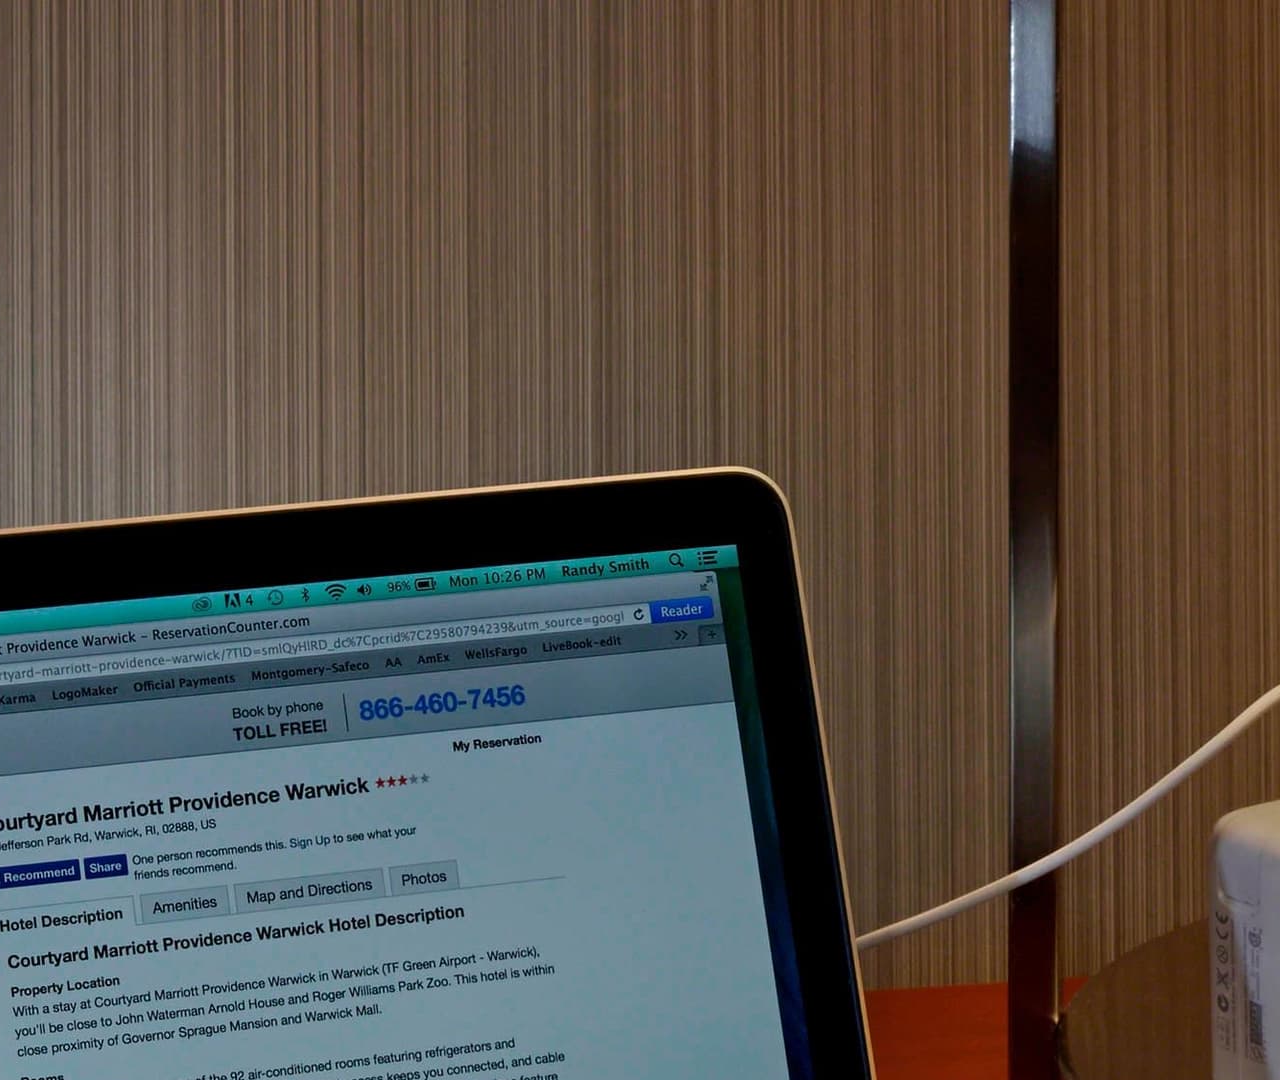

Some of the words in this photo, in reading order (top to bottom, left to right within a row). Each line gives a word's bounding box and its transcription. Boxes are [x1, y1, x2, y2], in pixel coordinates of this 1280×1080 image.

[561, 561, 605, 577] Randy
[608, 556, 650, 573] Smith
[448, 575, 478, 587] Mon
[483, 569, 522, 585] 10:26
[525, 567, 546, 581] PM
[660, 603, 702, 617] Reader
[6, 638, 79, 658] Providence
[81, 630, 138, 649] Warwick
[151, 617, 310, 641] ReservationCounter.com
[541, 634, 622, 653] LiveBook-edit
[416, 650, 450, 666] AmEx
[464, 642, 528, 661] WellsFargo
[251, 660, 370, 684] Montgomery-Safeco
[384, 656, 403, 669] AA
[51, 684, 119, 704] LogoMaker
[132, 677, 176, 696] Official
[178, 673, 236, 690] Payments
[231, 704, 265, 720] Book
[266, 703, 283, 718] by
[284, 700, 324, 717] phone
[358, 683, 526, 721] 866-460-7456
[232, 724, 277, 742] TOLL
[279, 718, 328, 737] FREE!
[452, 740, 471, 753] My
[472, 733, 542, 750] Reservation
[82, 798, 165, 823] Marriott
[168, 789, 280, 814] Providence
[284, 776, 370, 801] Warwick
[45, 833, 72, 846] Park
[72, 831, 92, 843] Rd,
[93, 826, 143, 841] Warwick,
[144, 824, 160, 836] RI,
[160, 820, 198, 834] 02888,
[199, 817, 217, 830] US
[131, 853, 155, 866] One
[155, 850, 193, 866] person
[194, 842, 264, 861] recommends
[264, 839, 287, 851] this.
[288, 837, 313, 850] Sign
[314, 834, 331, 847] Up
[332, 834, 344, 844] to
[345, 832, 365, 842] see
[366, 828, 392, 840] what
[393, 827, 416, 840] your
[3, 865, 75, 883] Recommend
[89, 862, 122, 874] Share
[133, 867, 170, 880] friends
[171, 858, 237, 876] recommend.
[401, 871, 447, 887] Photos
[246, 890, 276, 905] Map
[278, 884, 305, 901] and
[307, 879, 373, 897] Directions
[152, 896, 218, 915] Amenities
[40, 908, 123, 928] Description
[7, 945, 89, 969] Courtyard
[92, 939, 160, 960] Marriott
[162, 931, 253, 952] Providence
[255, 919, 325, 941] Warwick
[328, 914, 371, 933] Hotel
[374, 905, 465, 927] Description
[10, 982, 64, 999] Property
[66, 975, 120, 992] Location
